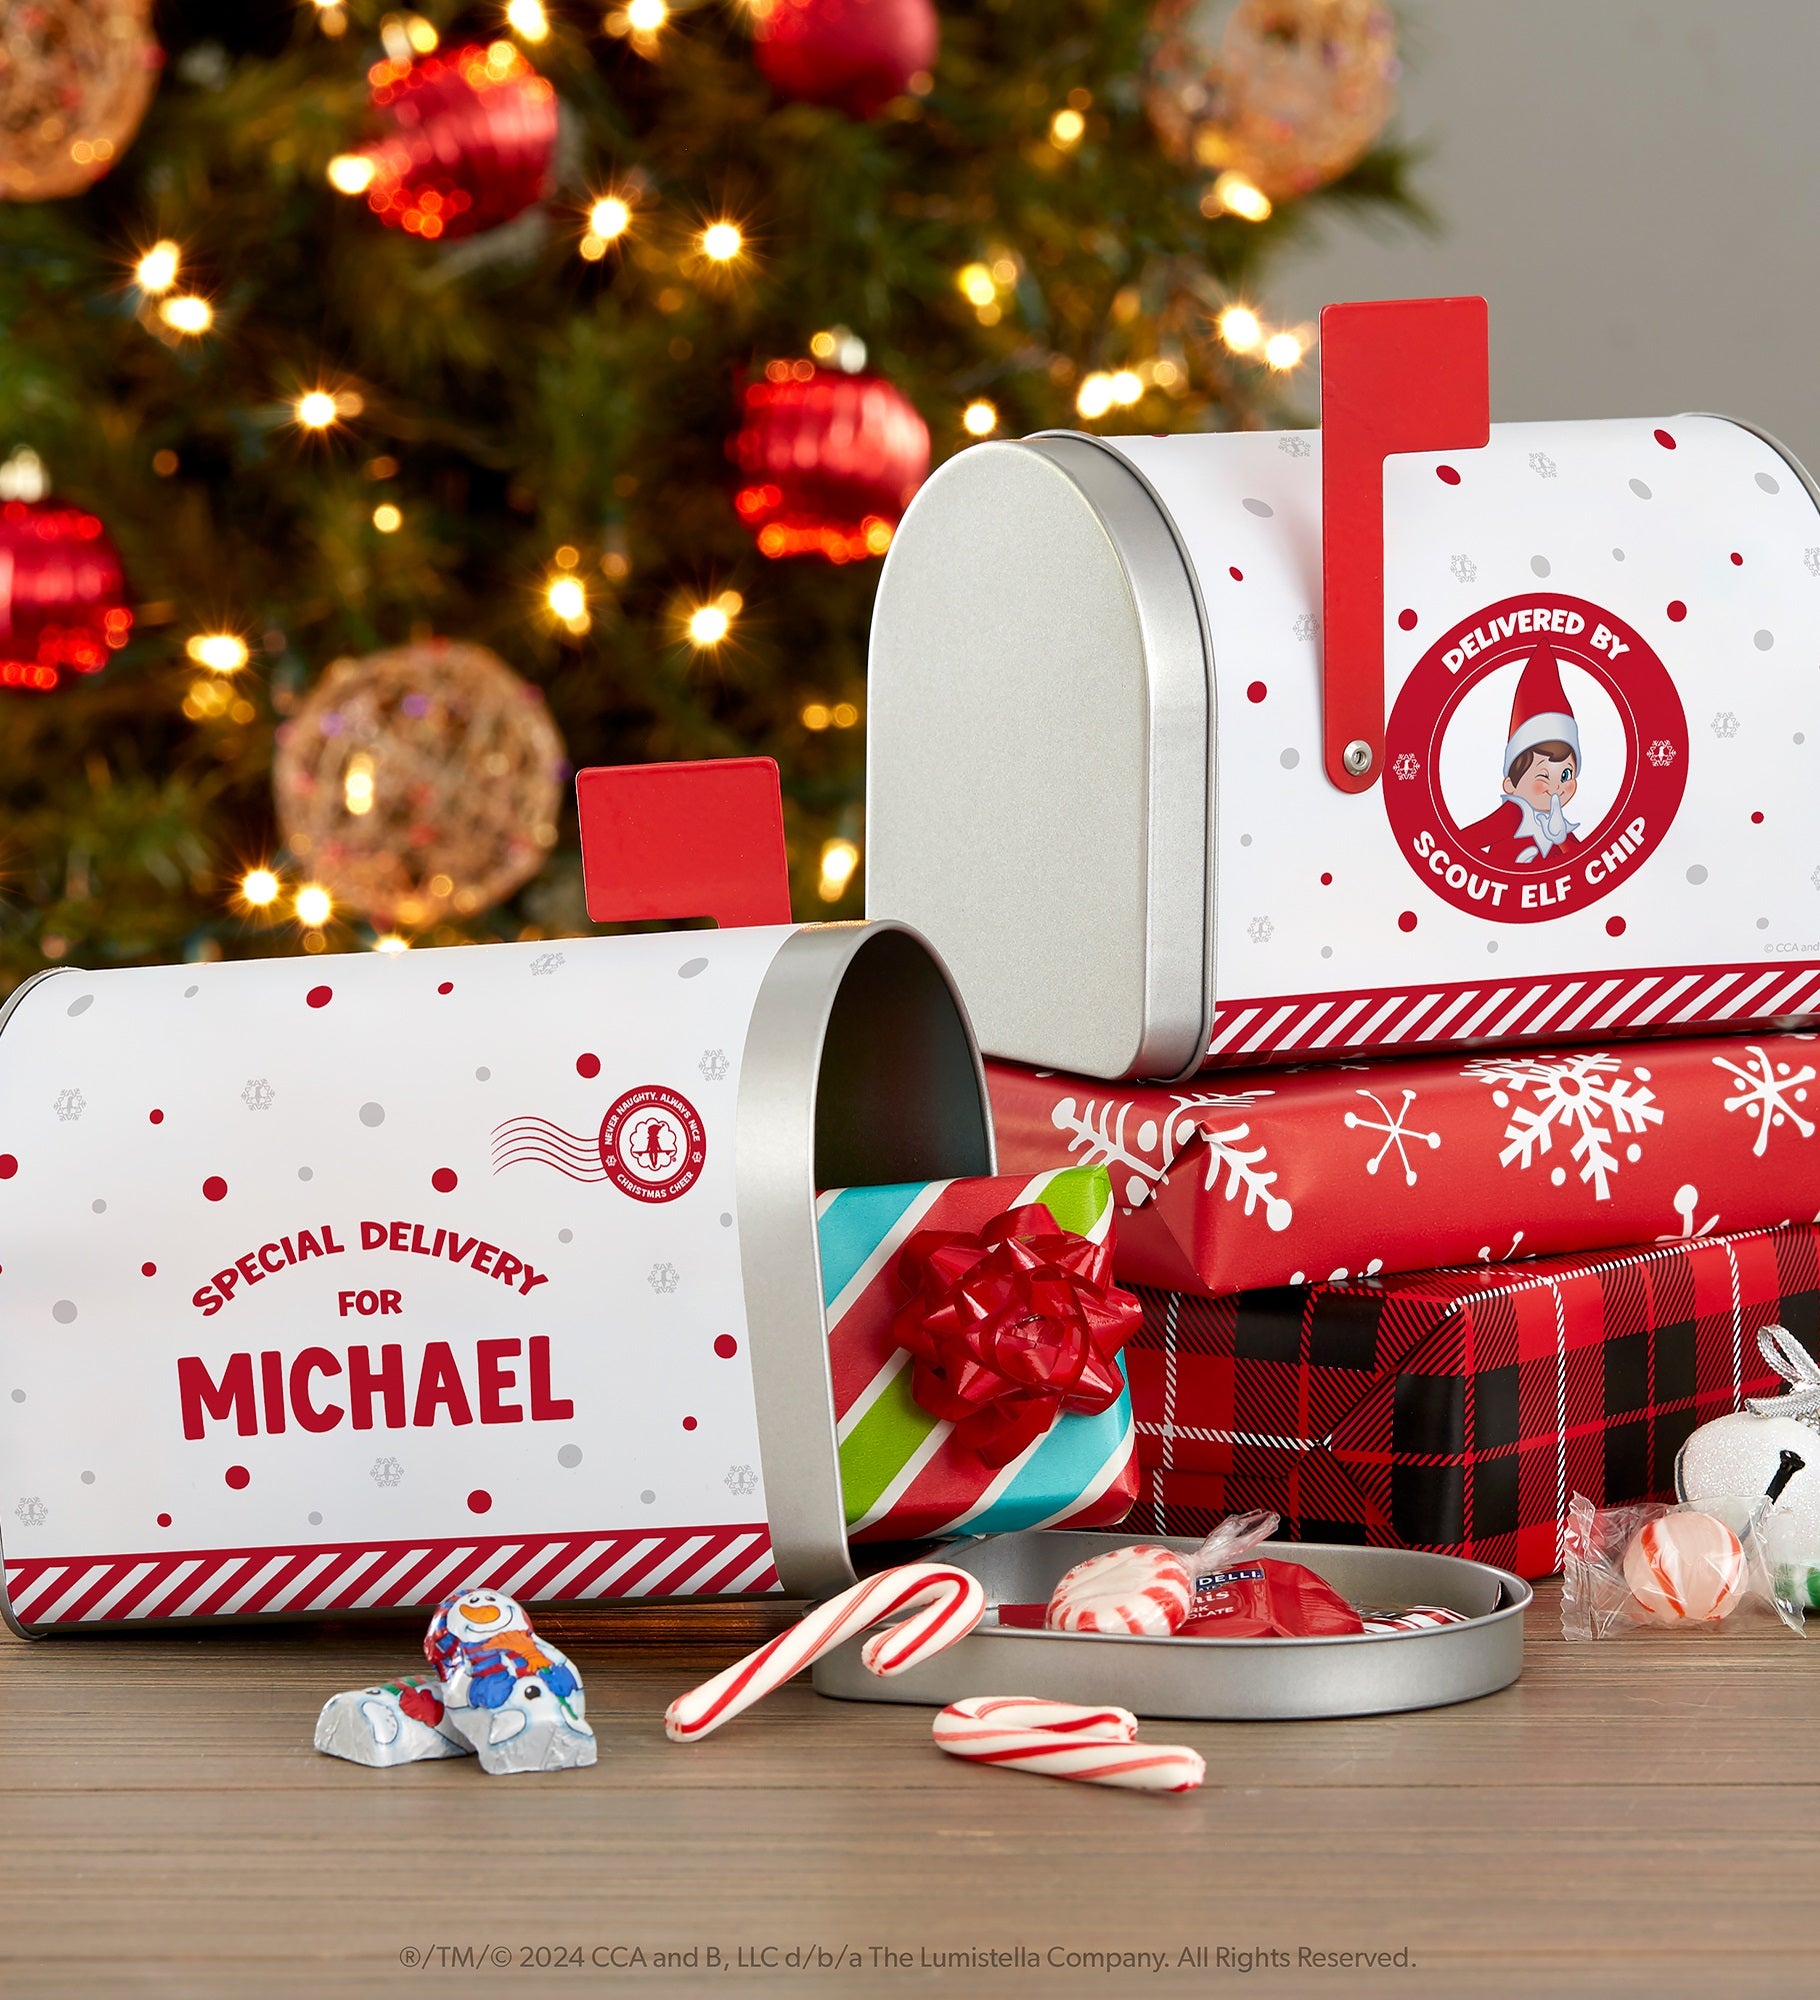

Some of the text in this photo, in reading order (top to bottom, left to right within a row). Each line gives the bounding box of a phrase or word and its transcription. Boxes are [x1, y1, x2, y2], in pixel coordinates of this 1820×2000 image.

[1441, 608, 1631, 675] DELIVERED BY
[1413, 816, 1646, 909] SCOUT ELF CHIP
[1776, 943, 1799, 952] CCA
[604, 1091, 701, 1146] NEVER NAUGHTY. ALWAYS NICE
[616, 1171, 694, 1199] CHRISTMAS CHEER
[192, 1221, 549, 1317] SPECIAL DELIVERY
[338, 1289, 403, 1317] FOR
[177, 1335, 574, 1441] MICHAEL
